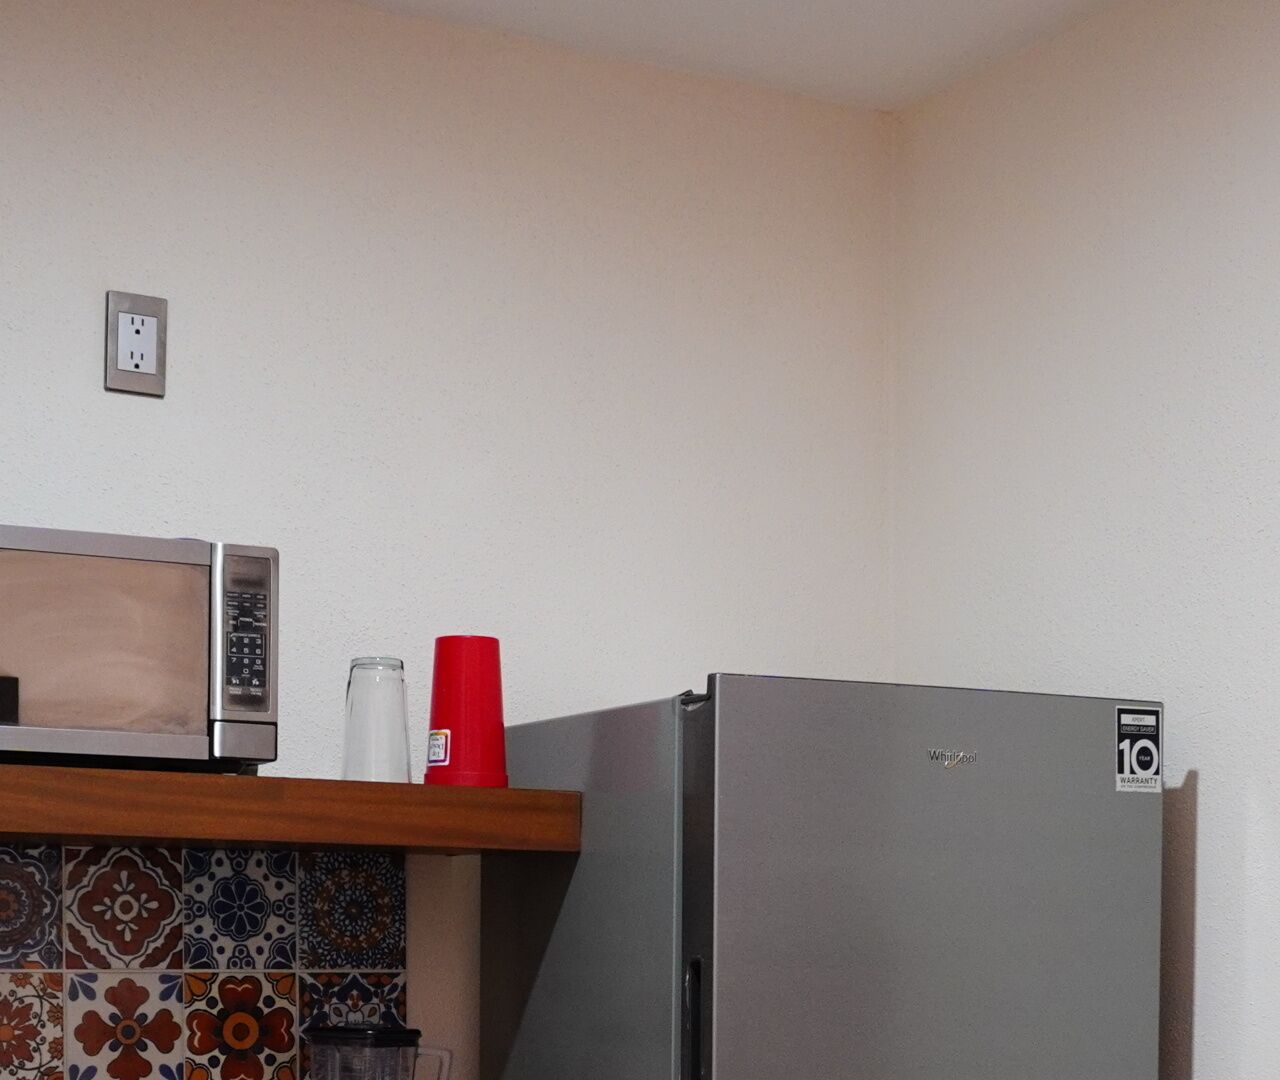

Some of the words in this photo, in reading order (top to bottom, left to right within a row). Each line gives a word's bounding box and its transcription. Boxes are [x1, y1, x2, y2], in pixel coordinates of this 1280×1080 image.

[928, 749, 977, 766] Whirlpool
[1119, 738, 1159, 776] 10
[1120, 776, 1158, 785] WARRANTY
